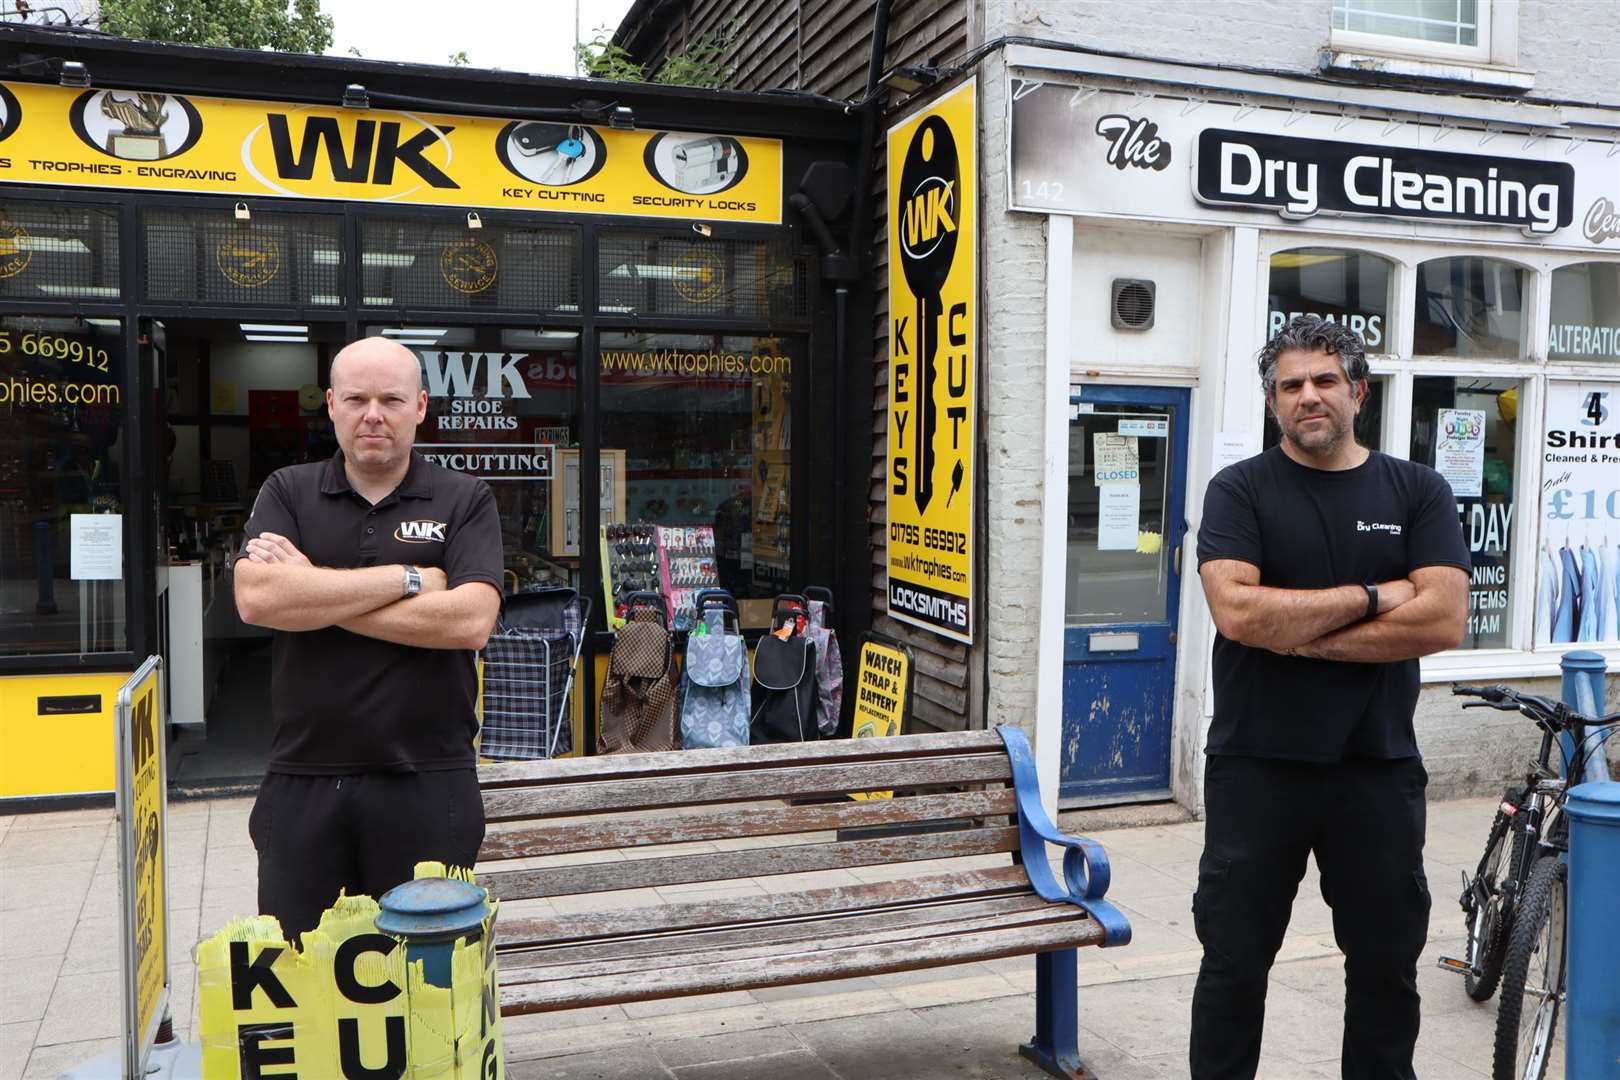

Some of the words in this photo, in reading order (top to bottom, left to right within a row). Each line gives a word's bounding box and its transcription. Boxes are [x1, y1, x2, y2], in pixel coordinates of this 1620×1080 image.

[267, 113, 461, 189] WK
[1096, 114, 1171, 170] The
[28, 160, 122, 175] TROPHIES
[138, 168, 236, 182] ENGRAVING
[503, 188, 533, 200] KEY
[538, 190, 605, 203] CUTTING
[1021, 180, 1064, 201] 142
[1221, 142, 1318, 213] Dry
[1344, 156, 1559, 232] Cleaning
[633, 195, 704, 209] SECURITY
[709, 199, 757, 212] LOCKS
[907, 180, 956, 247] WK
[22, 334, 109, 373] 669912
[601, 349, 792, 377] www.wktrophies.com
[421, 351, 532, 398] WK
[947, 302, 967, 449] CUT
[452, 401, 503, 414] SHOE
[893, 316, 909, 496] KEYS
[438, 415, 518, 430] REPAIRS
[423, 453, 549, 470] EYCUTTING
[1545, 453, 1587, 463] Cleaned
[1590, 454, 1598, 463] &
[1096, 470, 1138, 481] CLOSED
[400, 521, 447, 542] WK
[891, 522, 919, 546] 01795
[924, 527, 966, 555] 669912
[1471, 503, 1513, 552] DAY
[1470, 566, 1505, 585] NING
[891, 584, 967, 626] LOCKSMITHS
[865, 649, 902, 677] WATCH
[863, 670, 890, 690] STRAP
[860, 688, 897, 713] BATTERY
